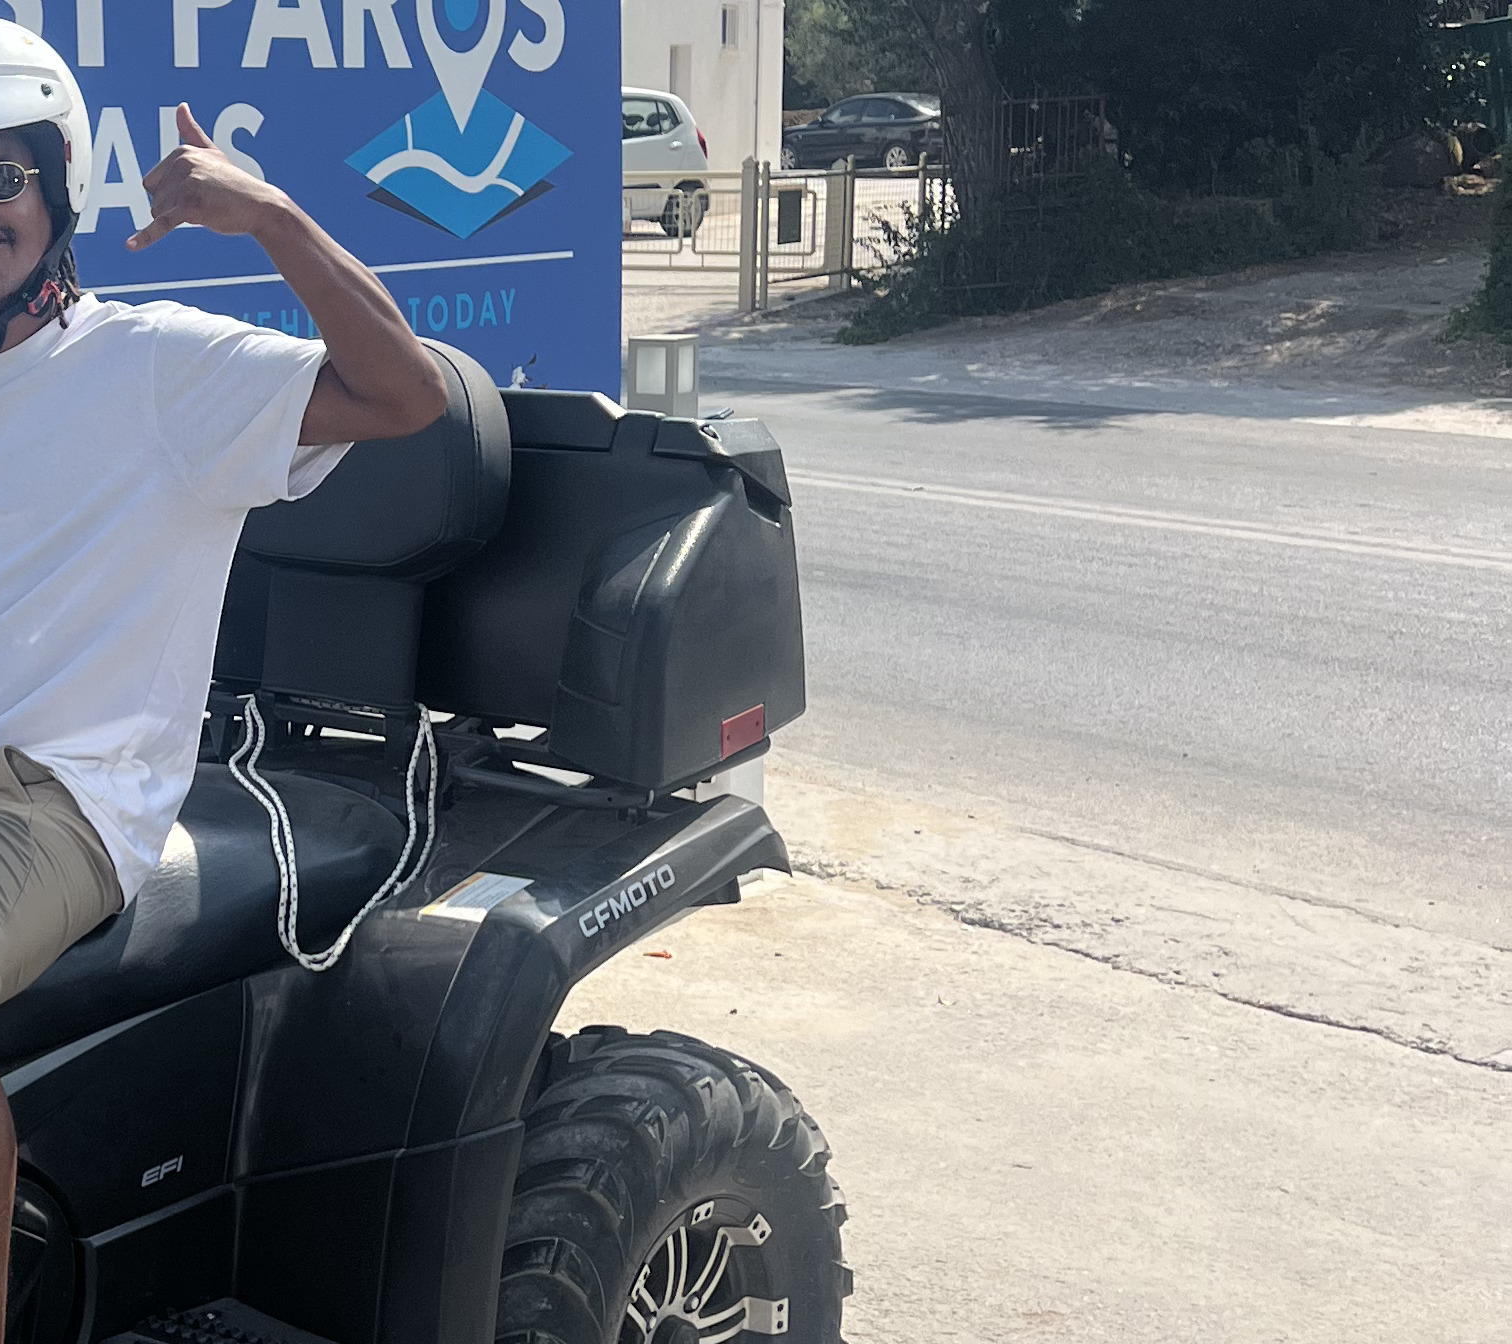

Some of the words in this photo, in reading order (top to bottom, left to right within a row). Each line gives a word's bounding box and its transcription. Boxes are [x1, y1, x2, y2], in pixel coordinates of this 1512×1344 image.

[407, 288, 516, 337] TODAY
[578, 863, 676, 938] CFMOTO
[141, 1155, 183, 1187] EFI
